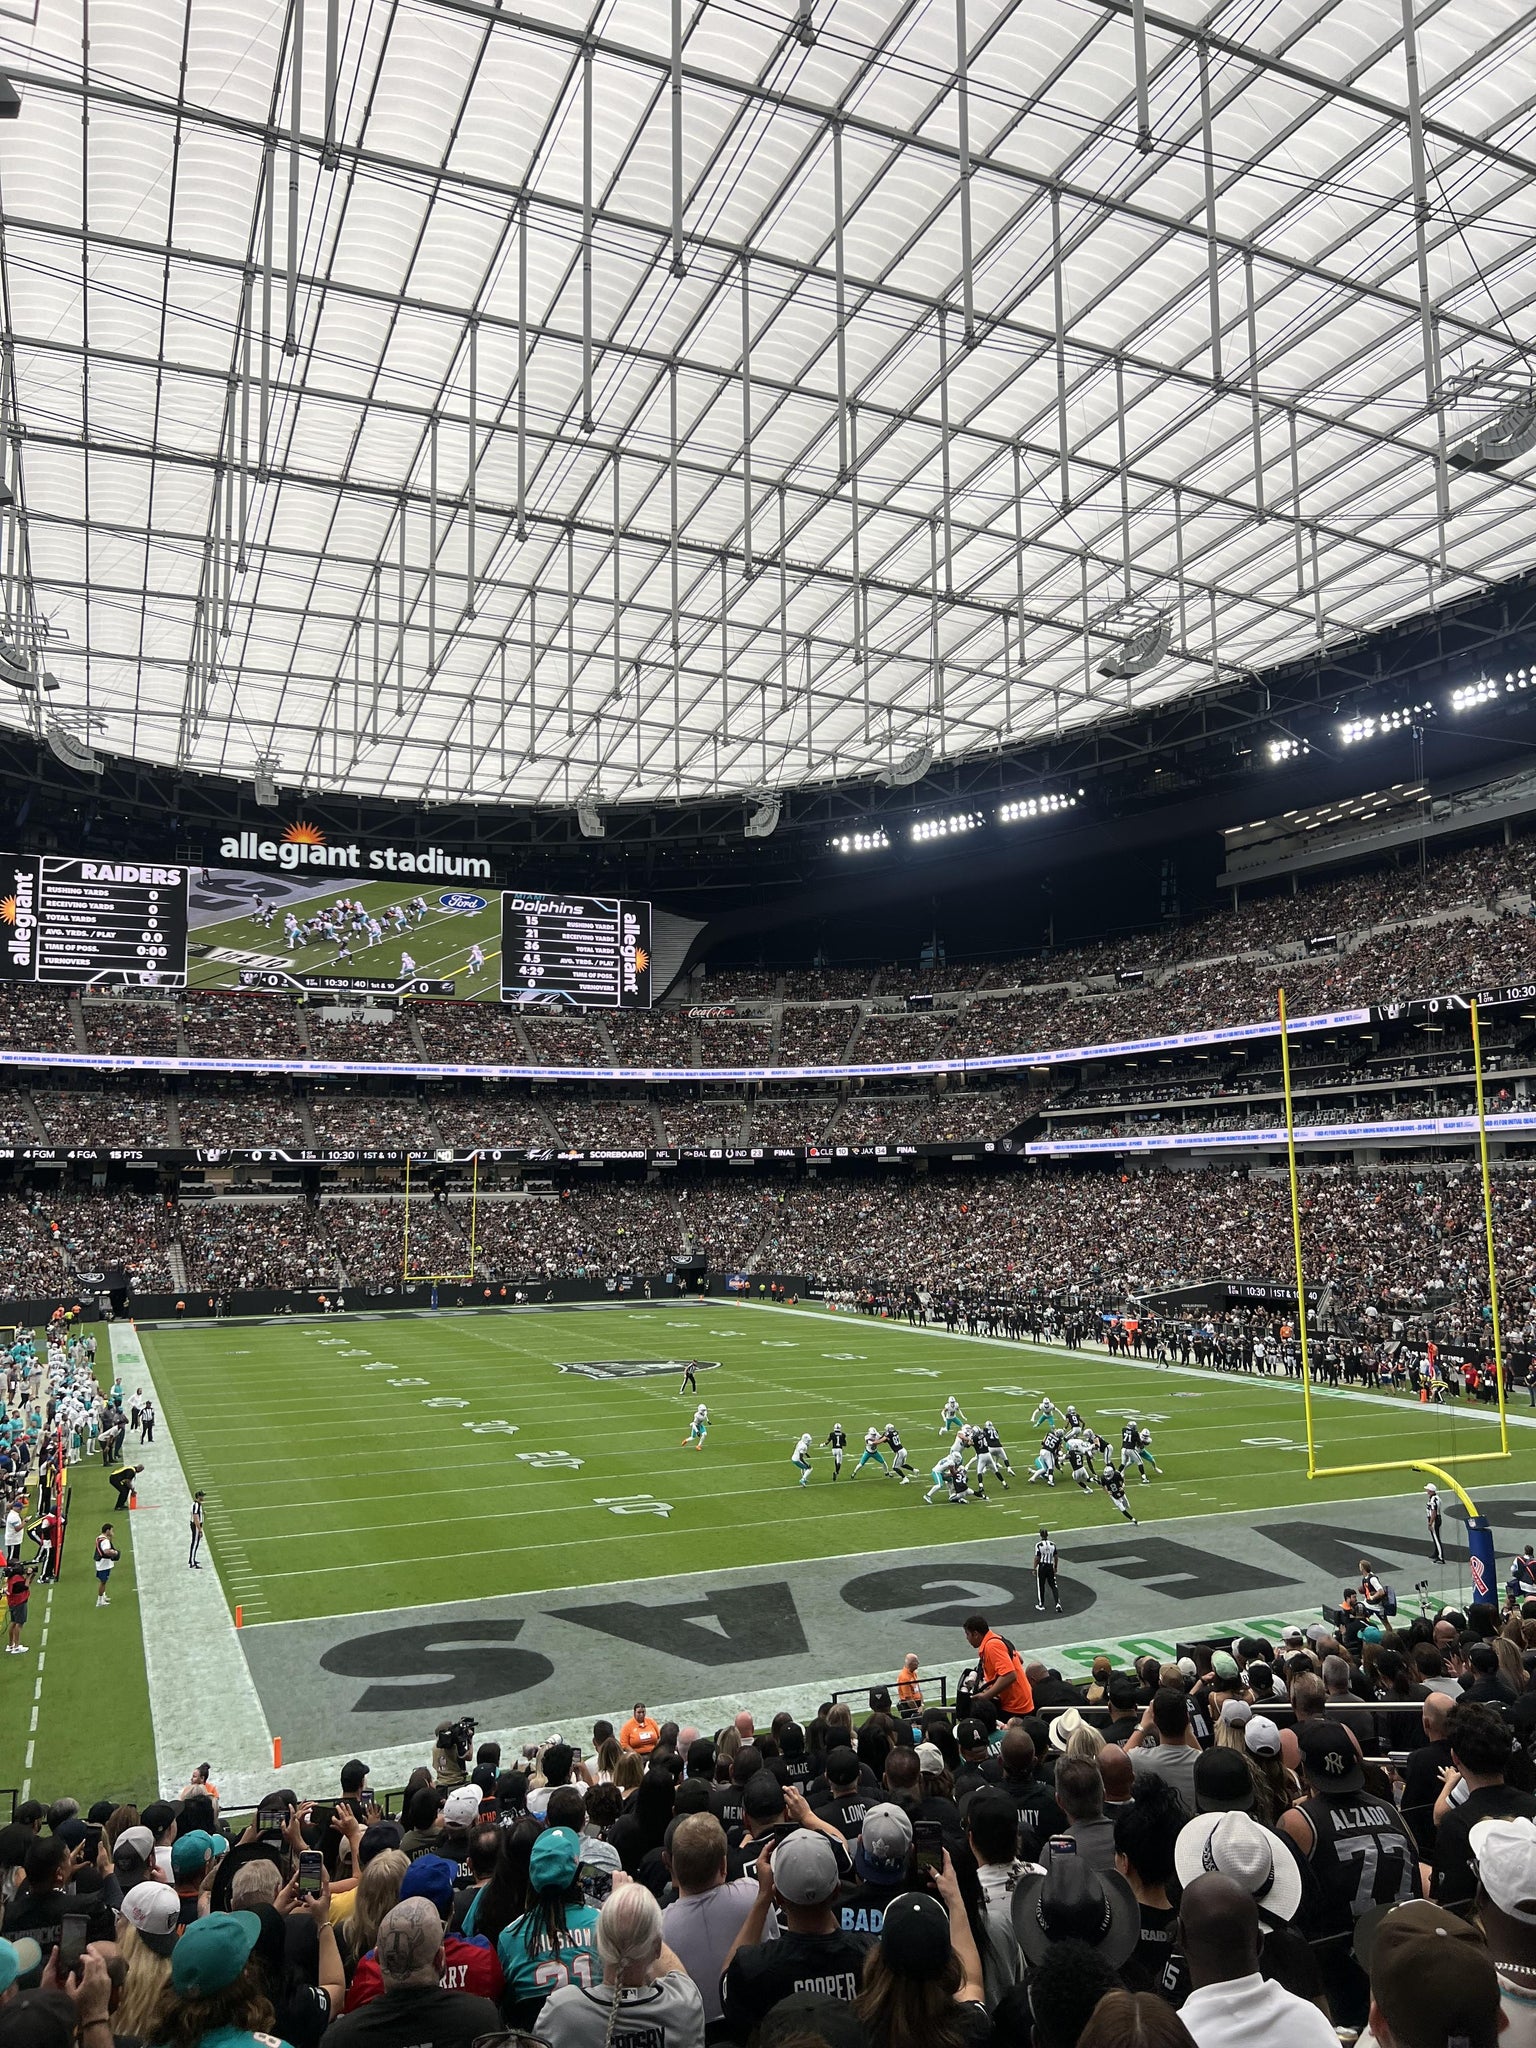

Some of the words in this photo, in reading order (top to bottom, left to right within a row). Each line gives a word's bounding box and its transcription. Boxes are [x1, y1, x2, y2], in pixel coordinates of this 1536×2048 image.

[220, 832, 360, 869] allegiant
[369, 847, 490, 878] stadium
[81, 863, 181, 886] RAIDERS
[47, 886, 82, 895] RUSHING
[83, 888, 109, 896] YARDS
[149, 891, 159, 901] 0
[46, 900, 88, 909] RECEIVING
[89, 902, 115, 911] YARDS
[447, 894, 478, 909] Ford
[148, 904, 158, 915] 0
[511, 899, 584, 916] Dolphins
[8, 872, 37, 966] allegiant
[46, 914, 70, 922] TOTAL
[71, 915, 96, 923] YARDS
[148, 918, 158, 928] 0
[525, 916, 539, 925] 15
[45, 928, 64, 936] AVG.
[66, 929, 89, 937] YRDS.
[96, 930, 116, 938] PLAY
[141, 932, 163, 943] 0.0
[525, 928, 539, 938] 21
[45, 943, 63, 951] TIME
[524, 941, 540, 950] 36
[136, 945, 167, 957] 0:00
[620, 913, 641, 993] allegiant
[44, 957, 90, 966] TURNOVERS
[523, 954, 540, 963] 4.5
[146, 959, 156, 970] 0
[519, 966, 544, 976] 4:29
[268, 974, 277, 986] 0
[324, 979, 349, 988] 10:30
[354, 980, 366, 988] 40
[528, 979, 536, 988] 0
[420, 982, 429, 993] 0
[1506, 985, 1536, 1000] 10:30
[1430, 1000, 1438, 1013] 0
[656, 1150, 670, 1158] NFL
[693, 1150, 708, 1158] BAL
[735, 1149, 747, 1157] IND
[774, 1148, 795, 1157] FINAL
[820, 1148, 833, 1156] CLE
[861, 1147, 874, 1155] JAX
[897, 1145, 918, 1153] FINAL
[23, 1150, 31, 1158] 4
[33, 1150, 55, 1159] FGM
[67, 1150, 76, 1158] 4
[77, 1151, 97, 1159] FGA
[110, 1150, 122, 1159] 15
[123, 1151, 143, 1159] PTS
[252, 1150, 262, 1160] 0
[328, 1151, 355, 1160] 10:30
[363, 1151, 378, 1159] 1ST
[387, 1151, 397, 1159] 10
[409, 1151, 420, 1159] ON
[421, 1151, 427, 1159] 7
[492, 1150, 501, 1160] 0
[590, 1150, 644, 1159] SCOREBOARD
[1246, 1287, 1266, 1297] 10:30
[1273, 1289, 1285, 1298] 1ST
[1286, 1290, 1292, 1298] &
[1308, 1291, 1318, 1300] 40
[1072, 1414, 1078, 1424] 9
[836, 1436, 841, 1446] 1
[1123, 1431, 1133, 1443] 71
[1044, 1437, 1056, 1449] 65
[515, 1450, 585, 1470] 20
[1076, 1454, 1082, 1466] 2
[1109, 1483, 1118, 1493] 8
[593, 1493, 674, 1518] 10
[320, 1520, 1518, 1713] VEGAS
[841, 1803, 867, 1825] LONG
[1330, 1806, 1391, 1832] ALZADO
[1334, 1833, 1415, 1917] 77
[841, 1907, 884, 1933] BAD
[794, 1972, 857, 2000] COOPER
